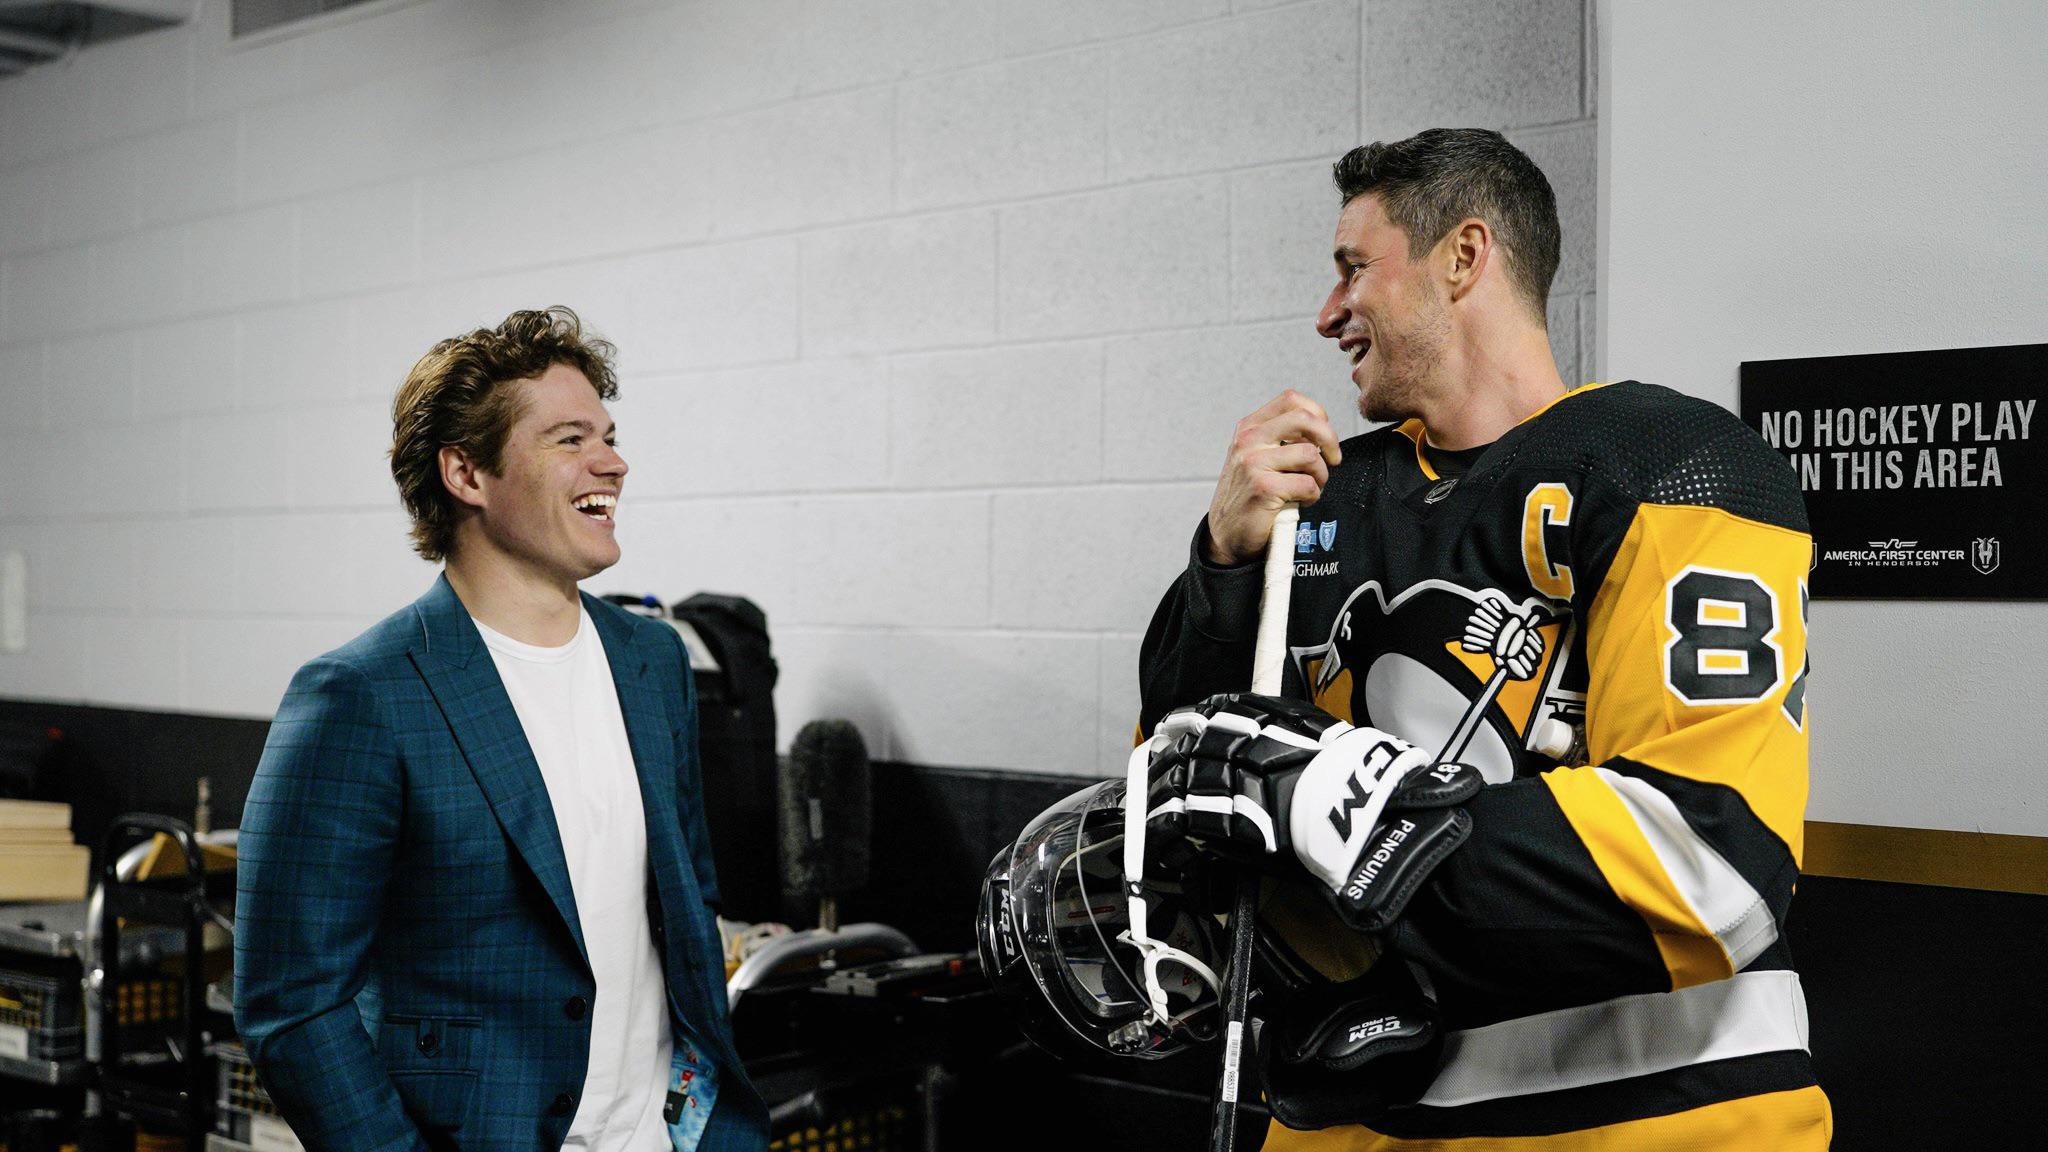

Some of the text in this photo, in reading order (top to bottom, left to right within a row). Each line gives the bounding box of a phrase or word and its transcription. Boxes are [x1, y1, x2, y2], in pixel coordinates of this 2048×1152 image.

[1762, 400, 2037, 448] NO HOCKEY PLAY
[1831, 451, 1903, 490] THIS
[1914, 447, 2003, 488] AREA
[1521, 482, 1575, 602] C
[1824, 550, 1965, 561] AMERICA FIRST CENTER
[1292, 561, 1339, 577] IGHMARK
[1664, 564, 1809, 733] 8
[1328, 737, 1417, 844] CM
[1430, 763, 1462, 784] 87
[1347, 819, 1416, 900] PENGUINS
[1348, 1020, 1401, 1042] CCM
[1361, 1017, 1384, 1029] PRO
